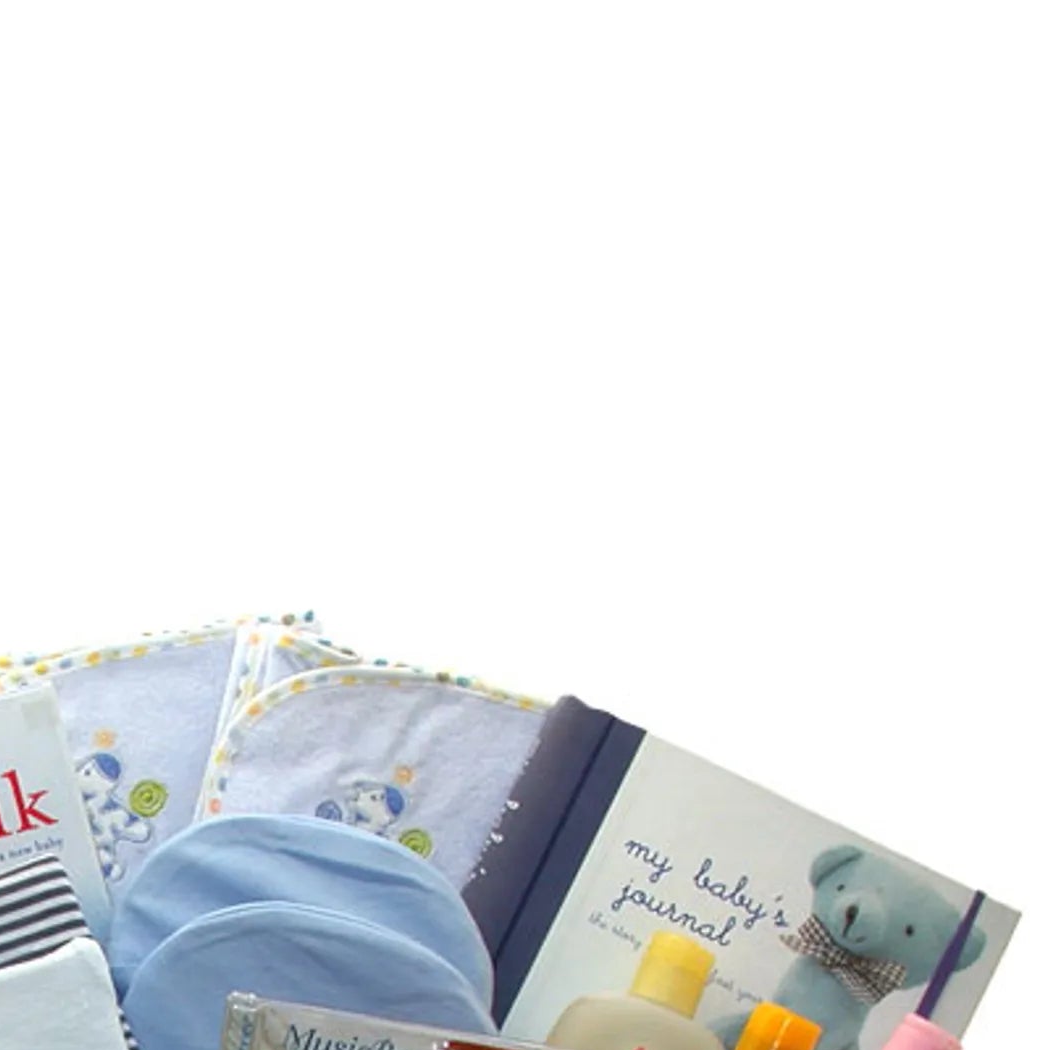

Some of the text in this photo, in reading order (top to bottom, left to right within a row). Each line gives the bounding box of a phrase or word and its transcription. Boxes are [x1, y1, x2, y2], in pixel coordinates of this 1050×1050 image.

[610, 878, 737, 946] journal
[624, 839, 788, 930] my baby's
